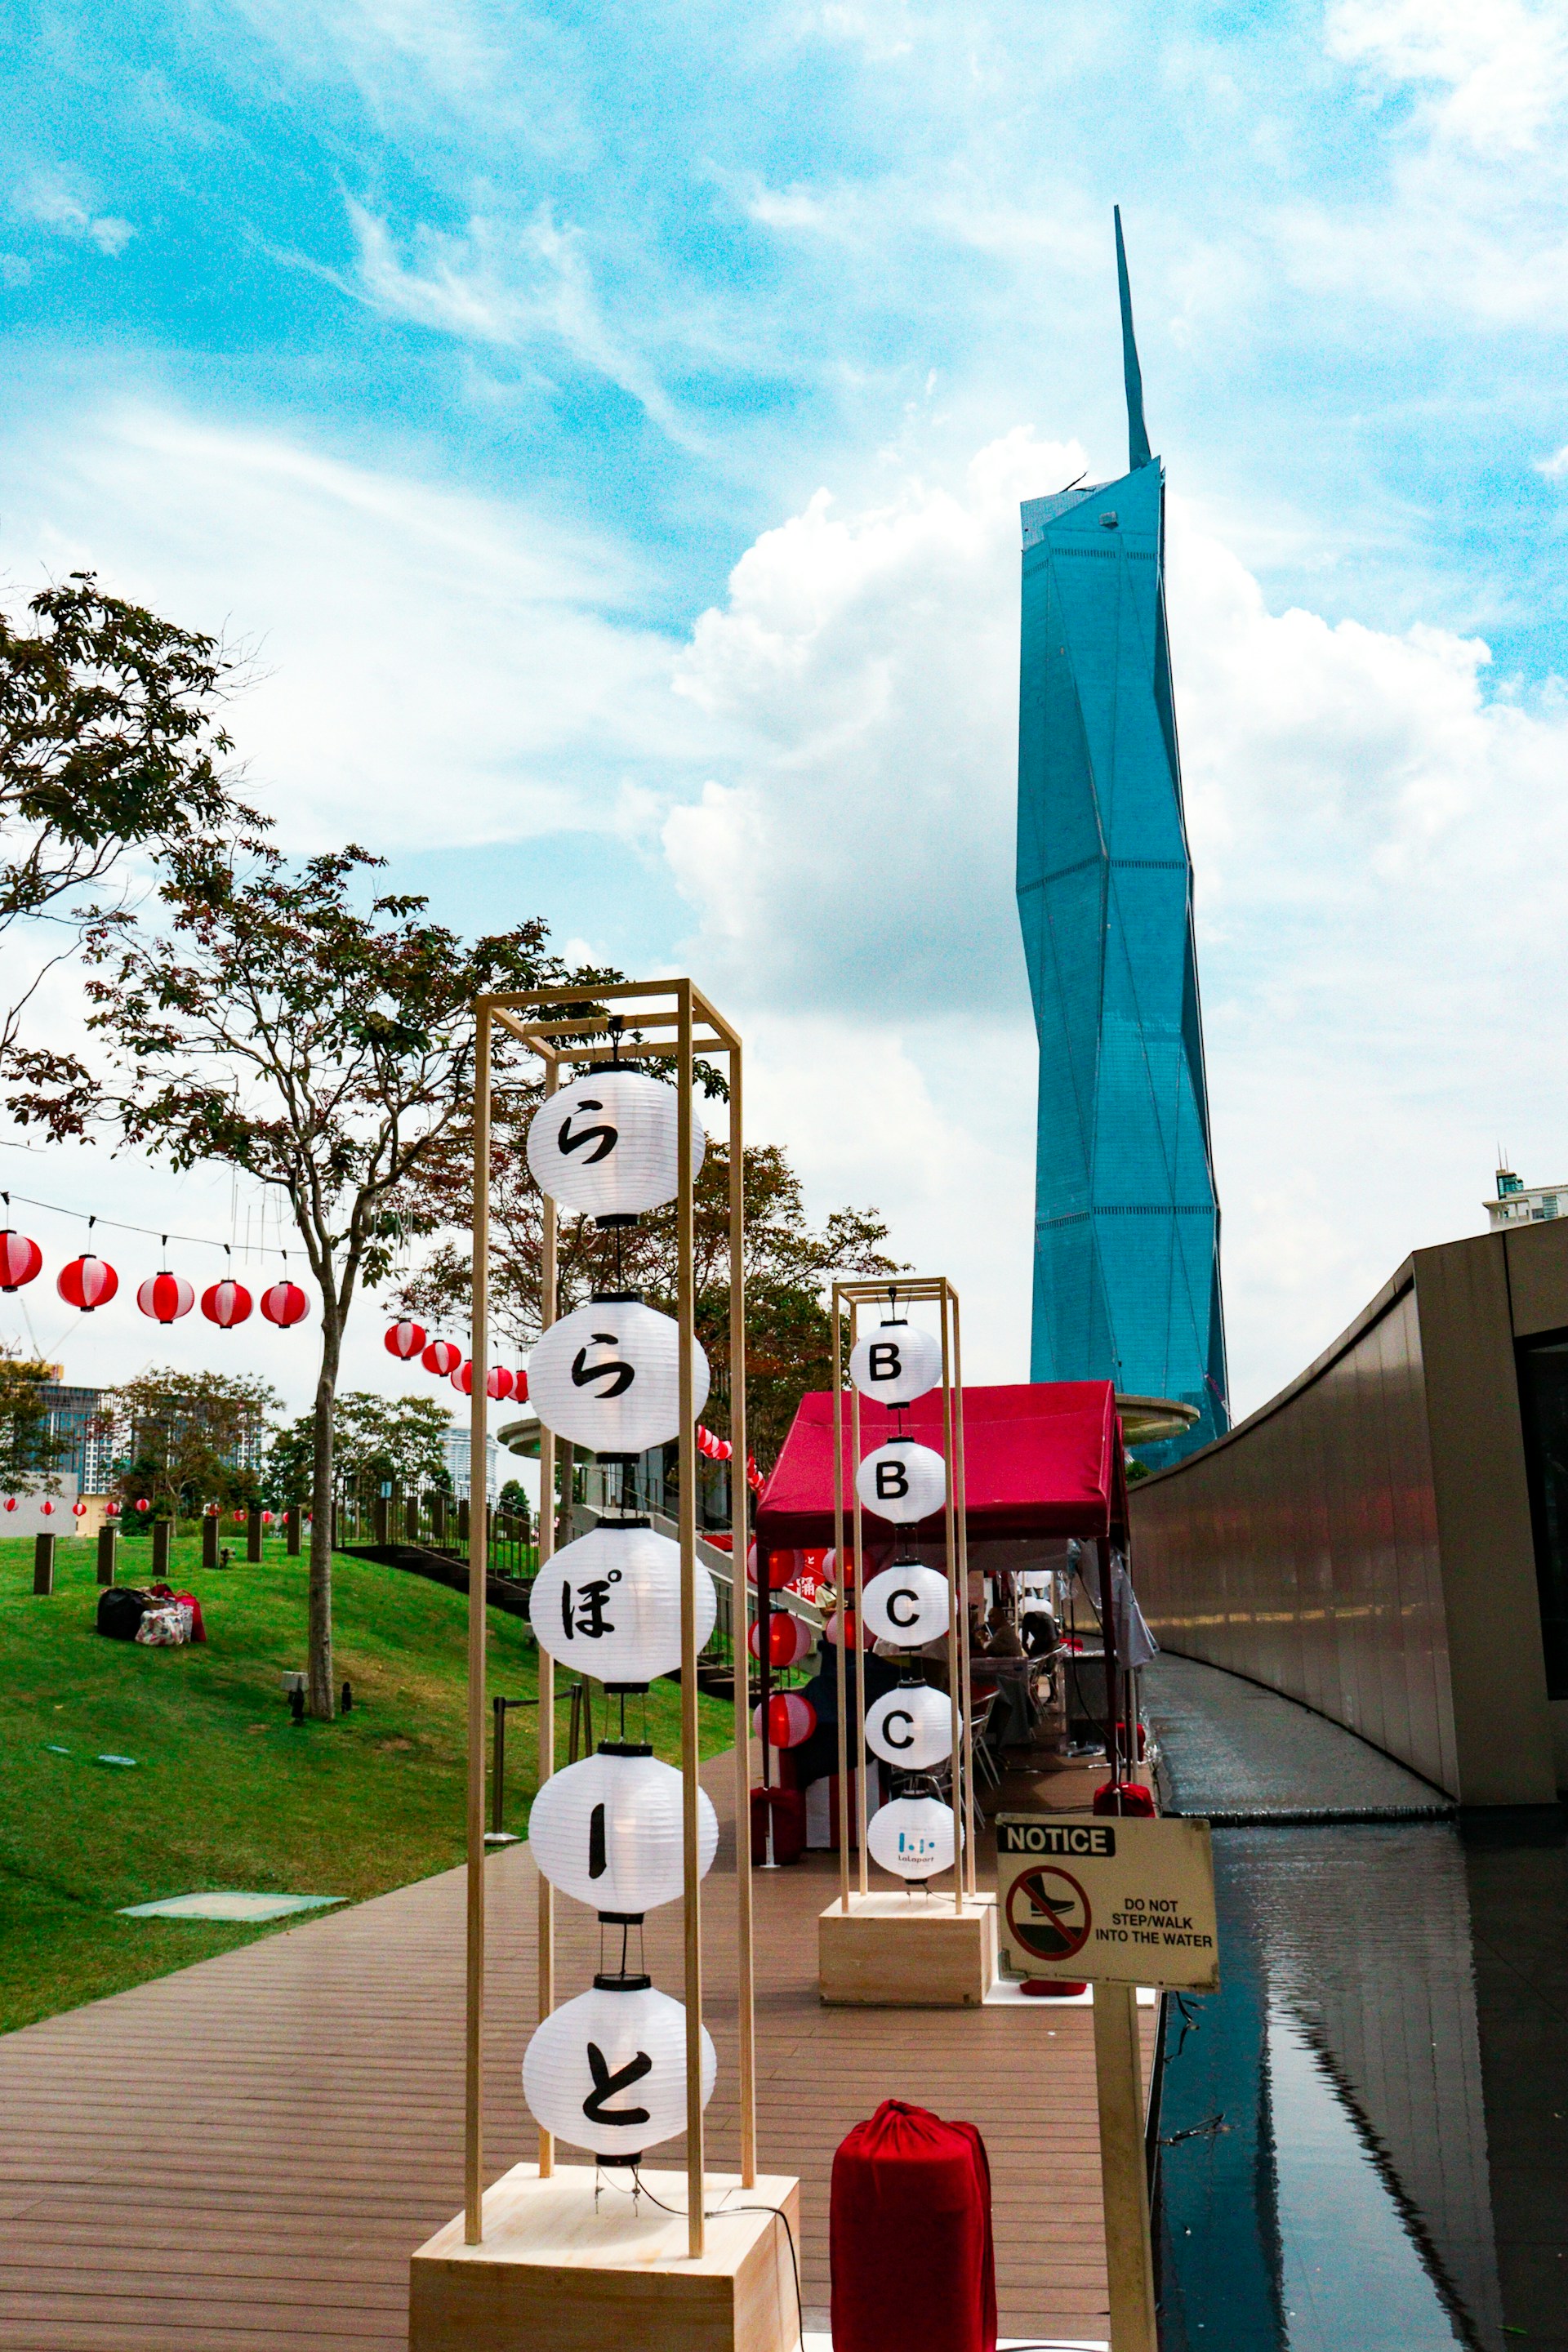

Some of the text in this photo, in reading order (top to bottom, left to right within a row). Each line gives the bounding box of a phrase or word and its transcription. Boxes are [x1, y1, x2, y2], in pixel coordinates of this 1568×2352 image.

[1007, 1826, 1107, 1854] NOTICE
[1125, 1898, 1178, 1913] DO NOT
[1112, 1913, 1193, 1930] STEP/WALK
[1095, 1929, 1213, 1948] INTO THE WATER
